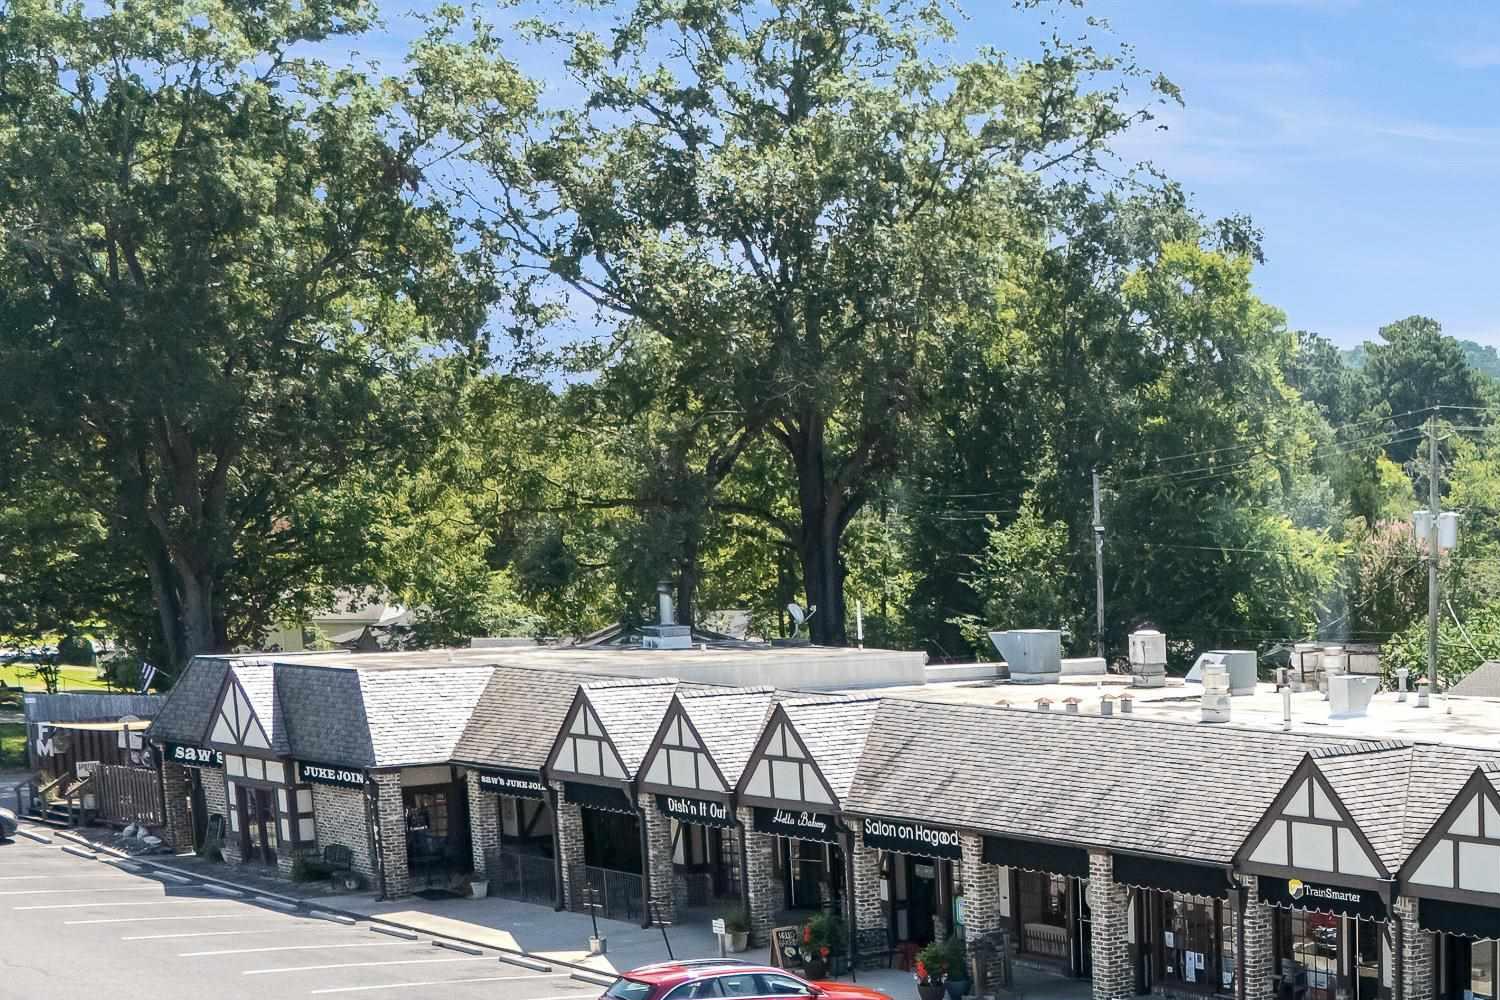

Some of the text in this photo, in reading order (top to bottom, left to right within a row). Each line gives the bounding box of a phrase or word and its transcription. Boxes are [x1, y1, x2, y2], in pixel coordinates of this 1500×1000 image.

[304, 766, 369, 785] JUKE JOIN
[668, 797, 727, 820] Dish'n It Out
[865, 818, 960, 847] Salon on Hagood
[1303, 884, 1361, 903] TrainSmarter
